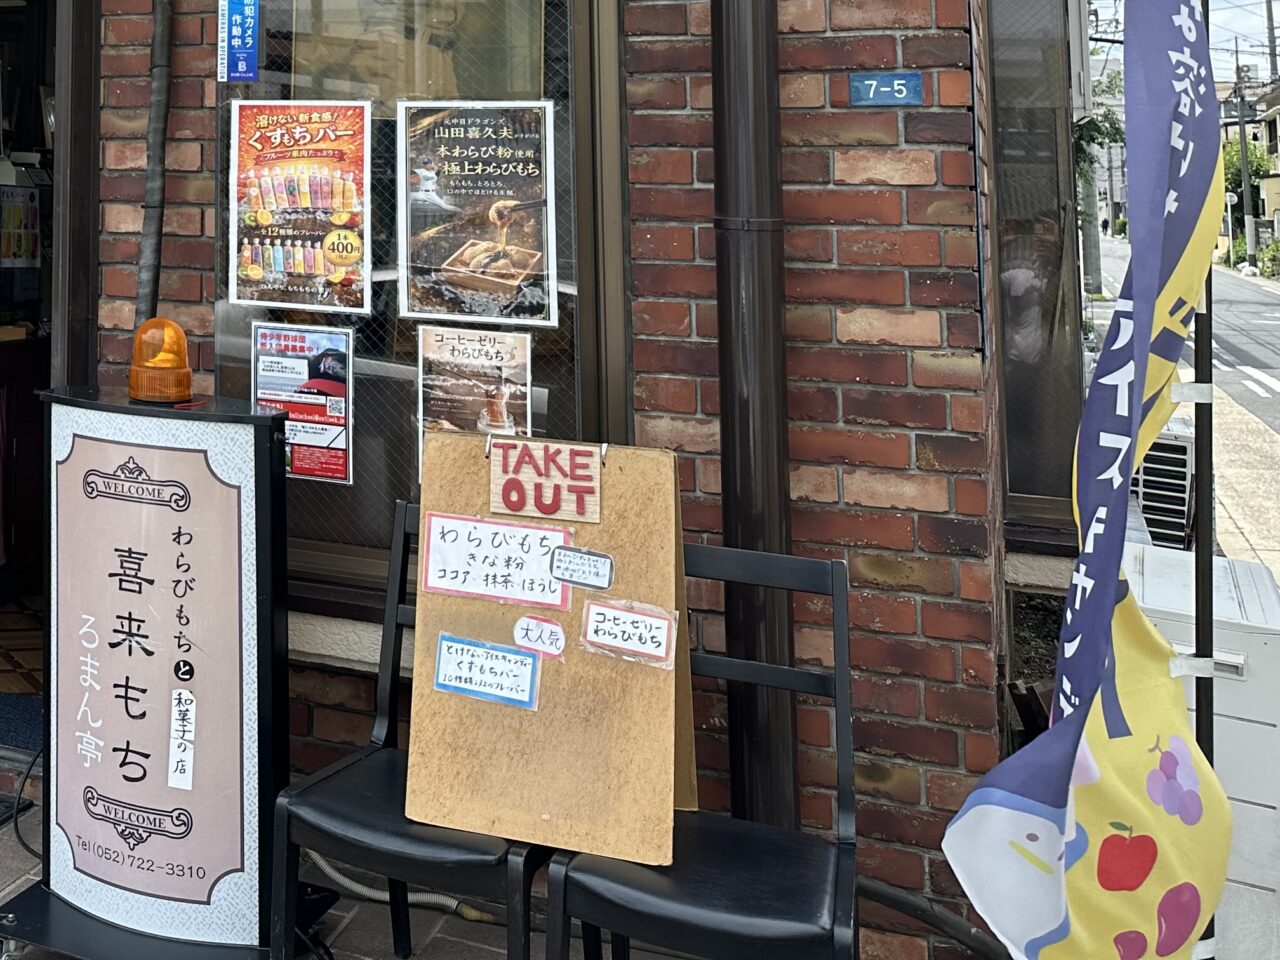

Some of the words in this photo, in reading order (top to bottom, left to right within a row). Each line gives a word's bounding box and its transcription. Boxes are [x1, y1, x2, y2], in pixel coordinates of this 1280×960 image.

[231, 14, 243, 49] 作動中
[864, 80, 907, 98] 7-5
[247, 125, 354, 151] くずもちバー
[441, 160, 540, 177] 極上わらびもち
[327, 241, 360, 255] 400円
[434, 333, 507, 347] コーヒーゼリー
[449, 345, 504, 362] わらびもち
[492, 442, 594, 482] TAKE
[102, 479, 166, 500] WELCOME
[501, 477, 596, 516] OUT
[438, 525, 552, 557] わらびもち
[466, 552, 528, 570] きな粉
[594, 612, 663, 632] コーヒーゼリー
[520, 622, 562, 652] 大人気
[592, 625, 663, 649] わらびもち
[107, 546, 156, 783] 喜来もち
[74, 614, 105, 768] ろまん亭
[102, 804, 167, 830] WELCOME
